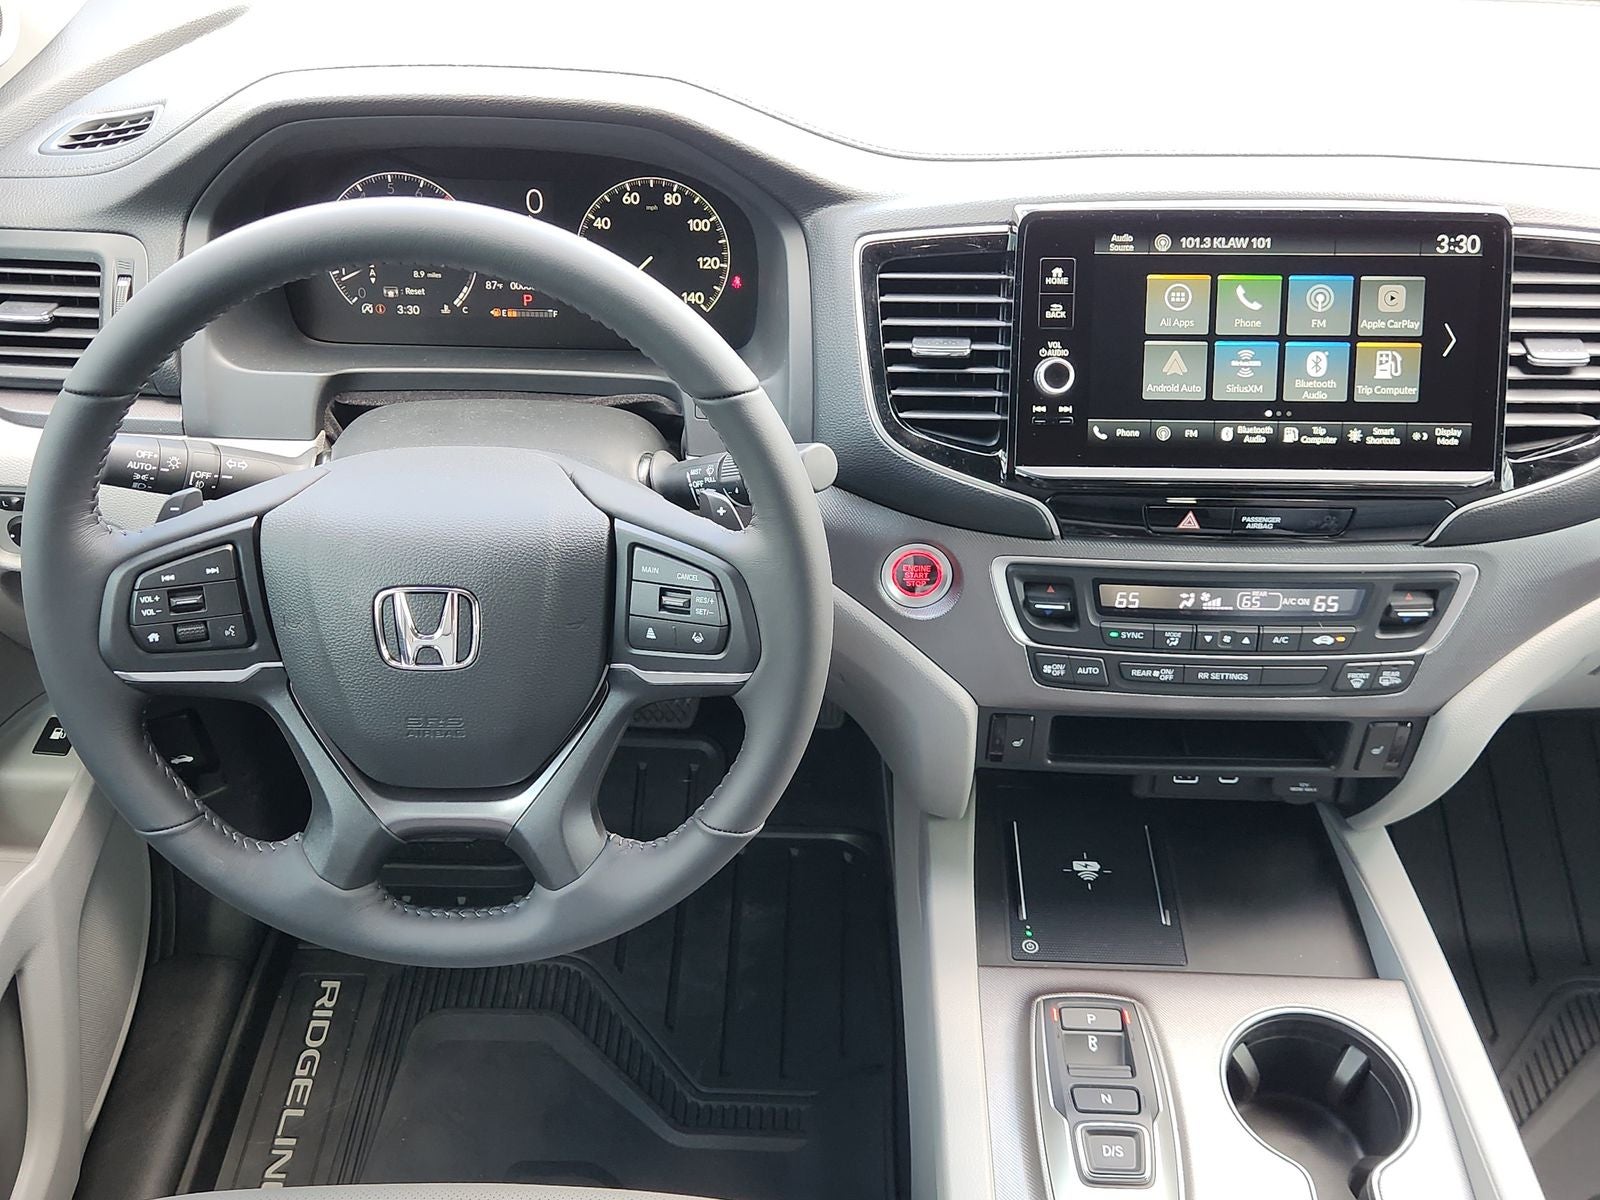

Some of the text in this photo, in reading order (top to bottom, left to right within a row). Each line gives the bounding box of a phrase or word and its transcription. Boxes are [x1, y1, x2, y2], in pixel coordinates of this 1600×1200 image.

[387, 183, 395, 195] 5
[526, 188, 543, 214] 0
[622, 192, 640, 205] 60
[663, 192, 682, 206] 80
[646, 204, 659, 212] mph
[593, 217, 611, 230] 40
[687, 218, 711, 232] 100
[1111, 233, 1134, 243] Audio
[1179, 236, 1272, 249] 101.3 KLAW 101
[1109, 243, 1135, 252] Source
[1435, 233, 1482, 254] 3:30
[696, 256, 721, 269] 120
[369, 268, 376, 277] A
[413, 270, 425, 278] 8.9
[1045, 276, 1069, 285] HOME
[357, 287, 367, 299] 0
[405, 287, 426, 296] Reset
[523, 294, 533, 306] P
[681, 291, 705, 305] 140
[396, 304, 421, 315] 3:30
[462, 306, 469, 314] C
[501, 309, 507, 317] E
[553, 310, 558, 318] F
[1045, 311, 1067, 319] BACK
[1160, 318, 1195, 329] All Apps
[1234, 318, 1262, 328] Phone
[1311, 319, 1327, 328] FM
[1360, 319, 1420, 330] Apple CarPlay
[1047, 341, 1063, 349] VOL
[1047, 348, 1069, 357] AUDIO
[1146, 383, 1202, 393] Android Auto
[1225, 383, 1264, 393] SiriusXM
[1295, 378, 1337, 388] Bluetooth
[1302, 391, 1328, 400] Audio
[1357, 385, 1418, 397] Trip Computer
[1115, 428, 1141, 438] Phone
[1184, 429, 1199, 438] FM
[1237, 425, 1274, 435] Bluetooth
[1311, 426, 1328, 436] Trip
[1372, 427, 1395, 436] Smart
[1434, 427, 1463, 438] Display
[1243, 434, 1267, 444] Audio
[1300, 435, 1338, 446] Computer
[1365, 436, 1401, 445] Shortcuts
[1437, 436, 1460, 446] Mode
[136, 449, 154, 459] OFF
[127, 462, 152, 471] AUTO
[194, 470, 213, 480] OFF
[704, 476, 717, 484] PULL
[692, 480, 704, 488] OFF
[1241, 516, 1282, 524] PASSENGER
[641, 566, 660, 574] MAIN
[902, 564, 932, 572] ENGINE
[676, 572, 699, 582] CANCEL
[1114, 592, 1140, 609] 65
[1241, 596, 1261, 608] 65
[1282, 597, 1310, 606] A/C ON
[1312, 596, 1340, 613] 65
[1120, 631, 1145, 640] SYNC
[1272, 635, 1290, 644] A/C
[1051, 663, 1066, 671] ON/
[1077, 666, 1100, 675] AUTO
[1131, 669, 1152, 677] REAR
[1198, 672, 1249, 682] RR SETTINGS
[1086, 1013, 1097, 1025] P
[1100, 1093, 1113, 1105] N
[1102, 1144, 1125, 1158] D/S
